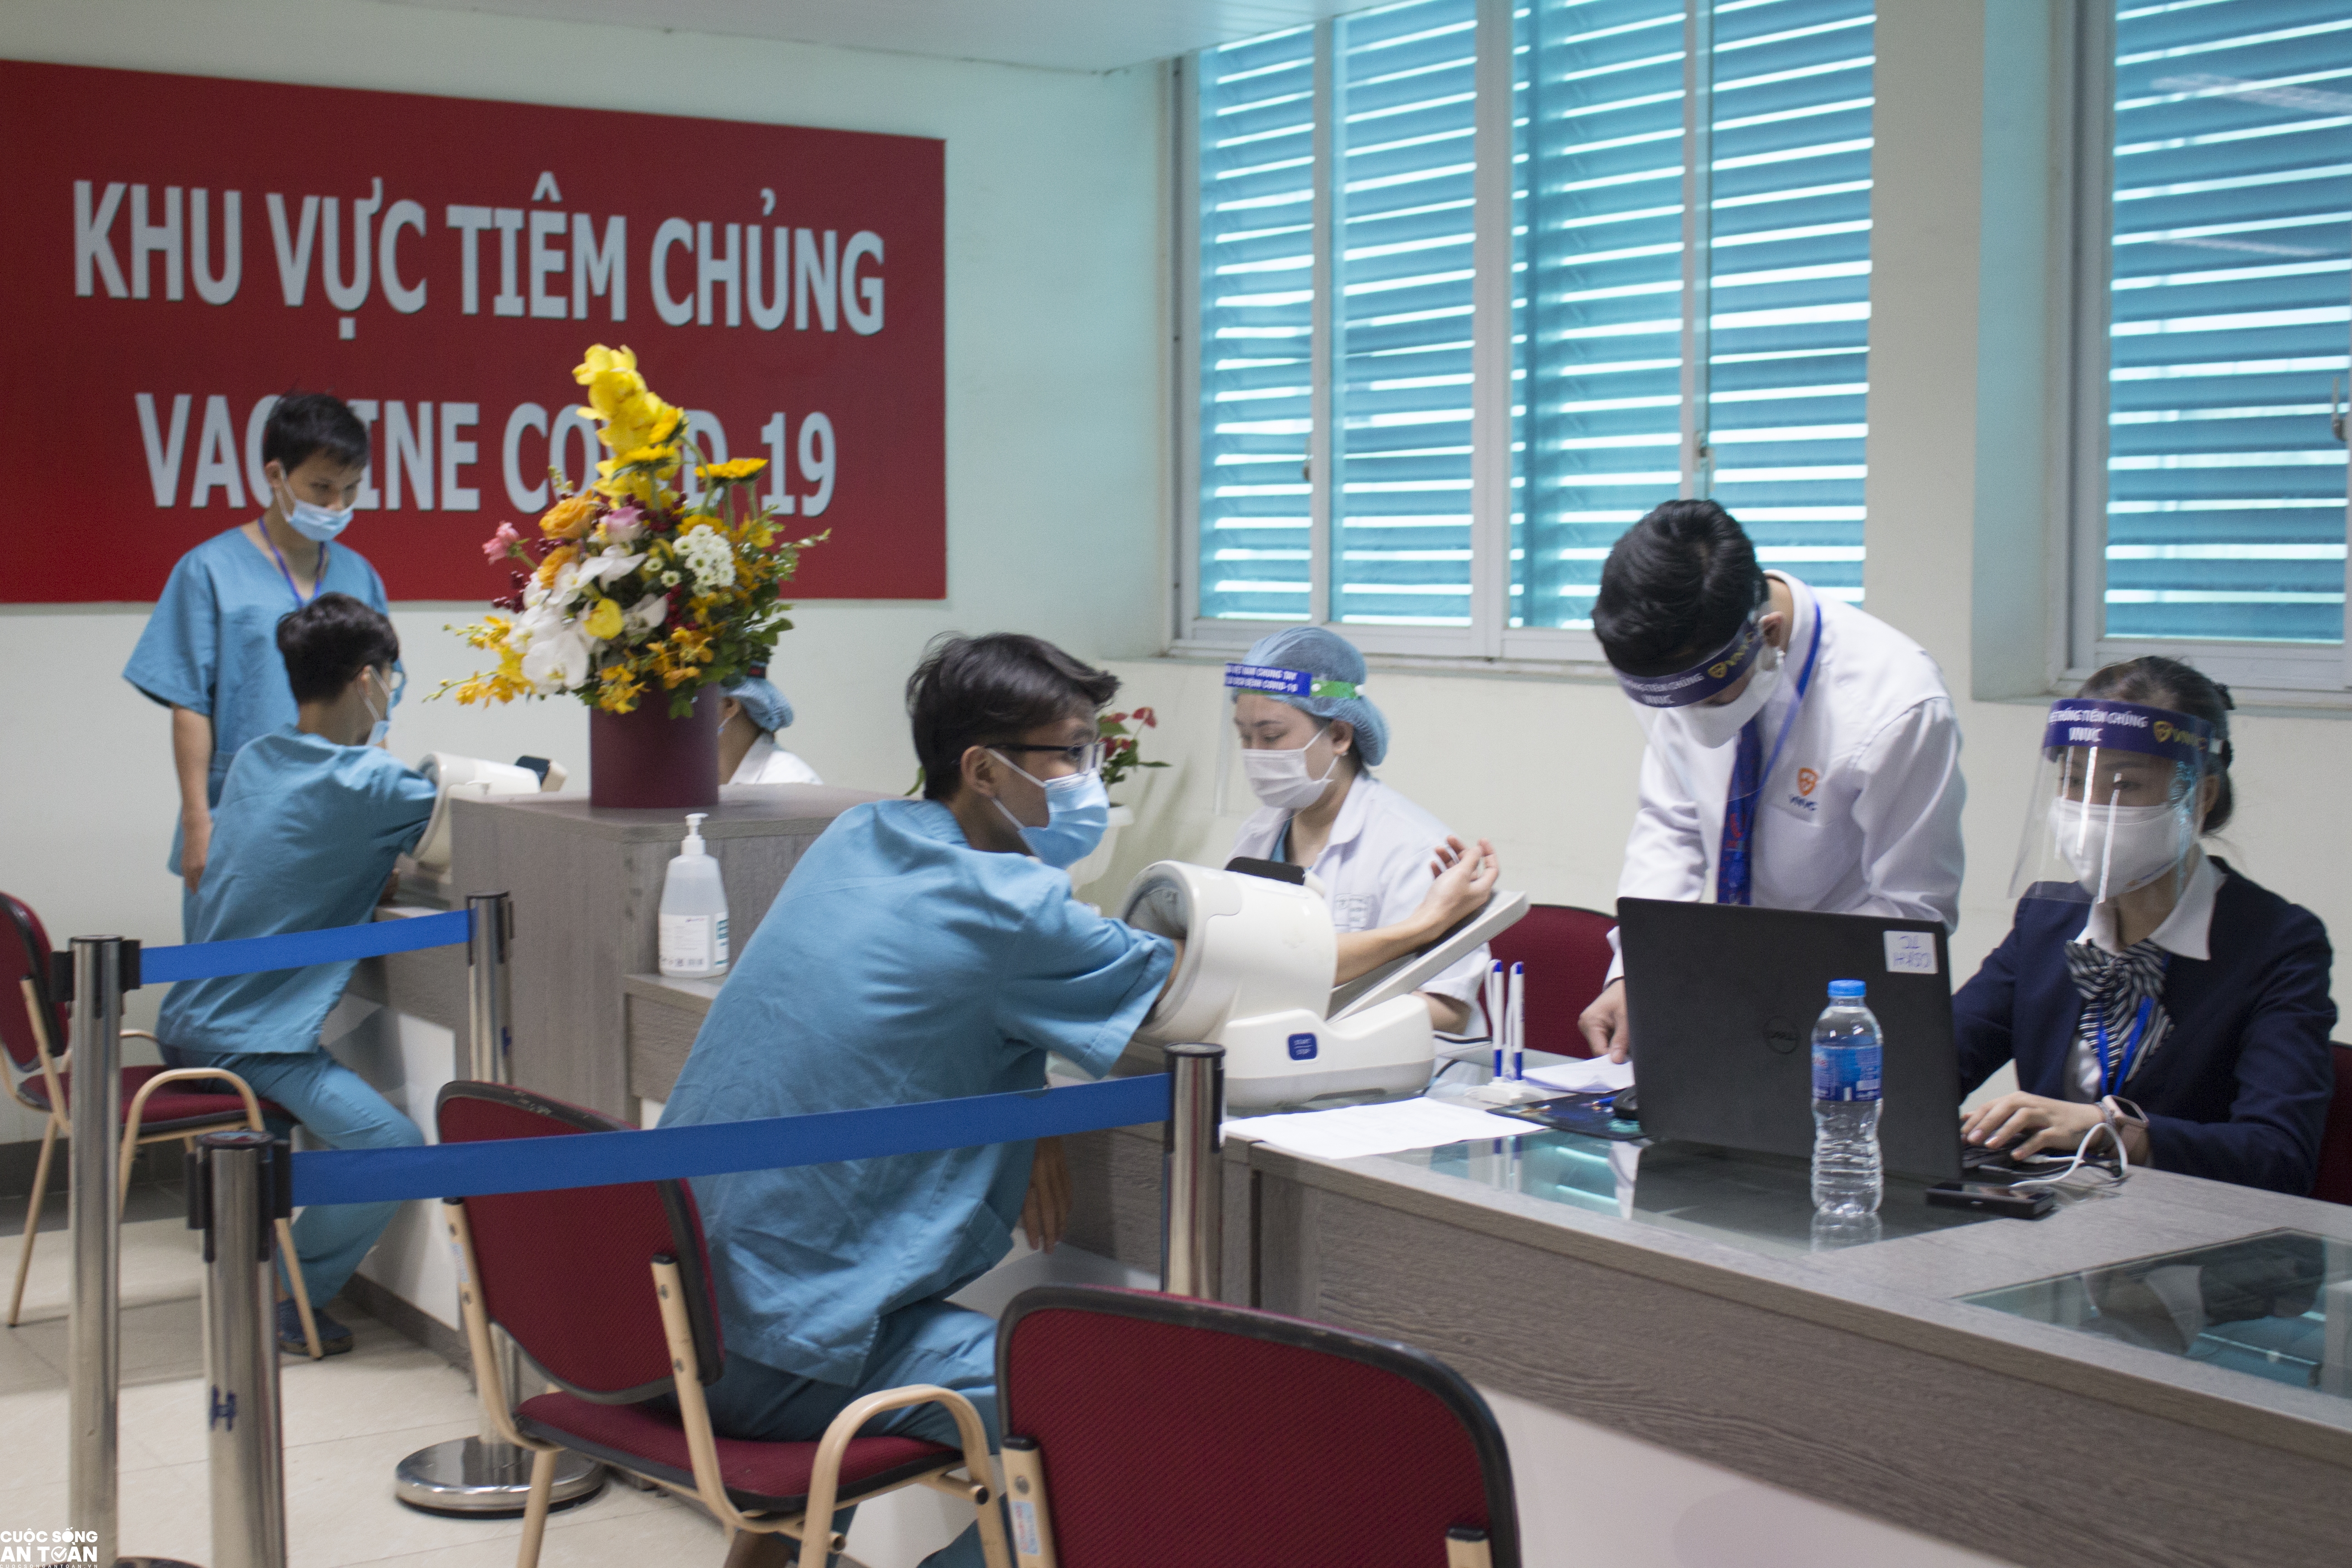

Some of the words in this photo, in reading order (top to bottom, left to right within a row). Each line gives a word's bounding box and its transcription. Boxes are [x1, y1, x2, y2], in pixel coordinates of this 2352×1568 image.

[74, 180, 242, 306] KHU
[265, 176, 426, 340] VỰC
[446, 172, 627, 322] TIÊM
[650, 187, 884, 336] CHỦNG
[135, 392, 480, 512] VACINE
